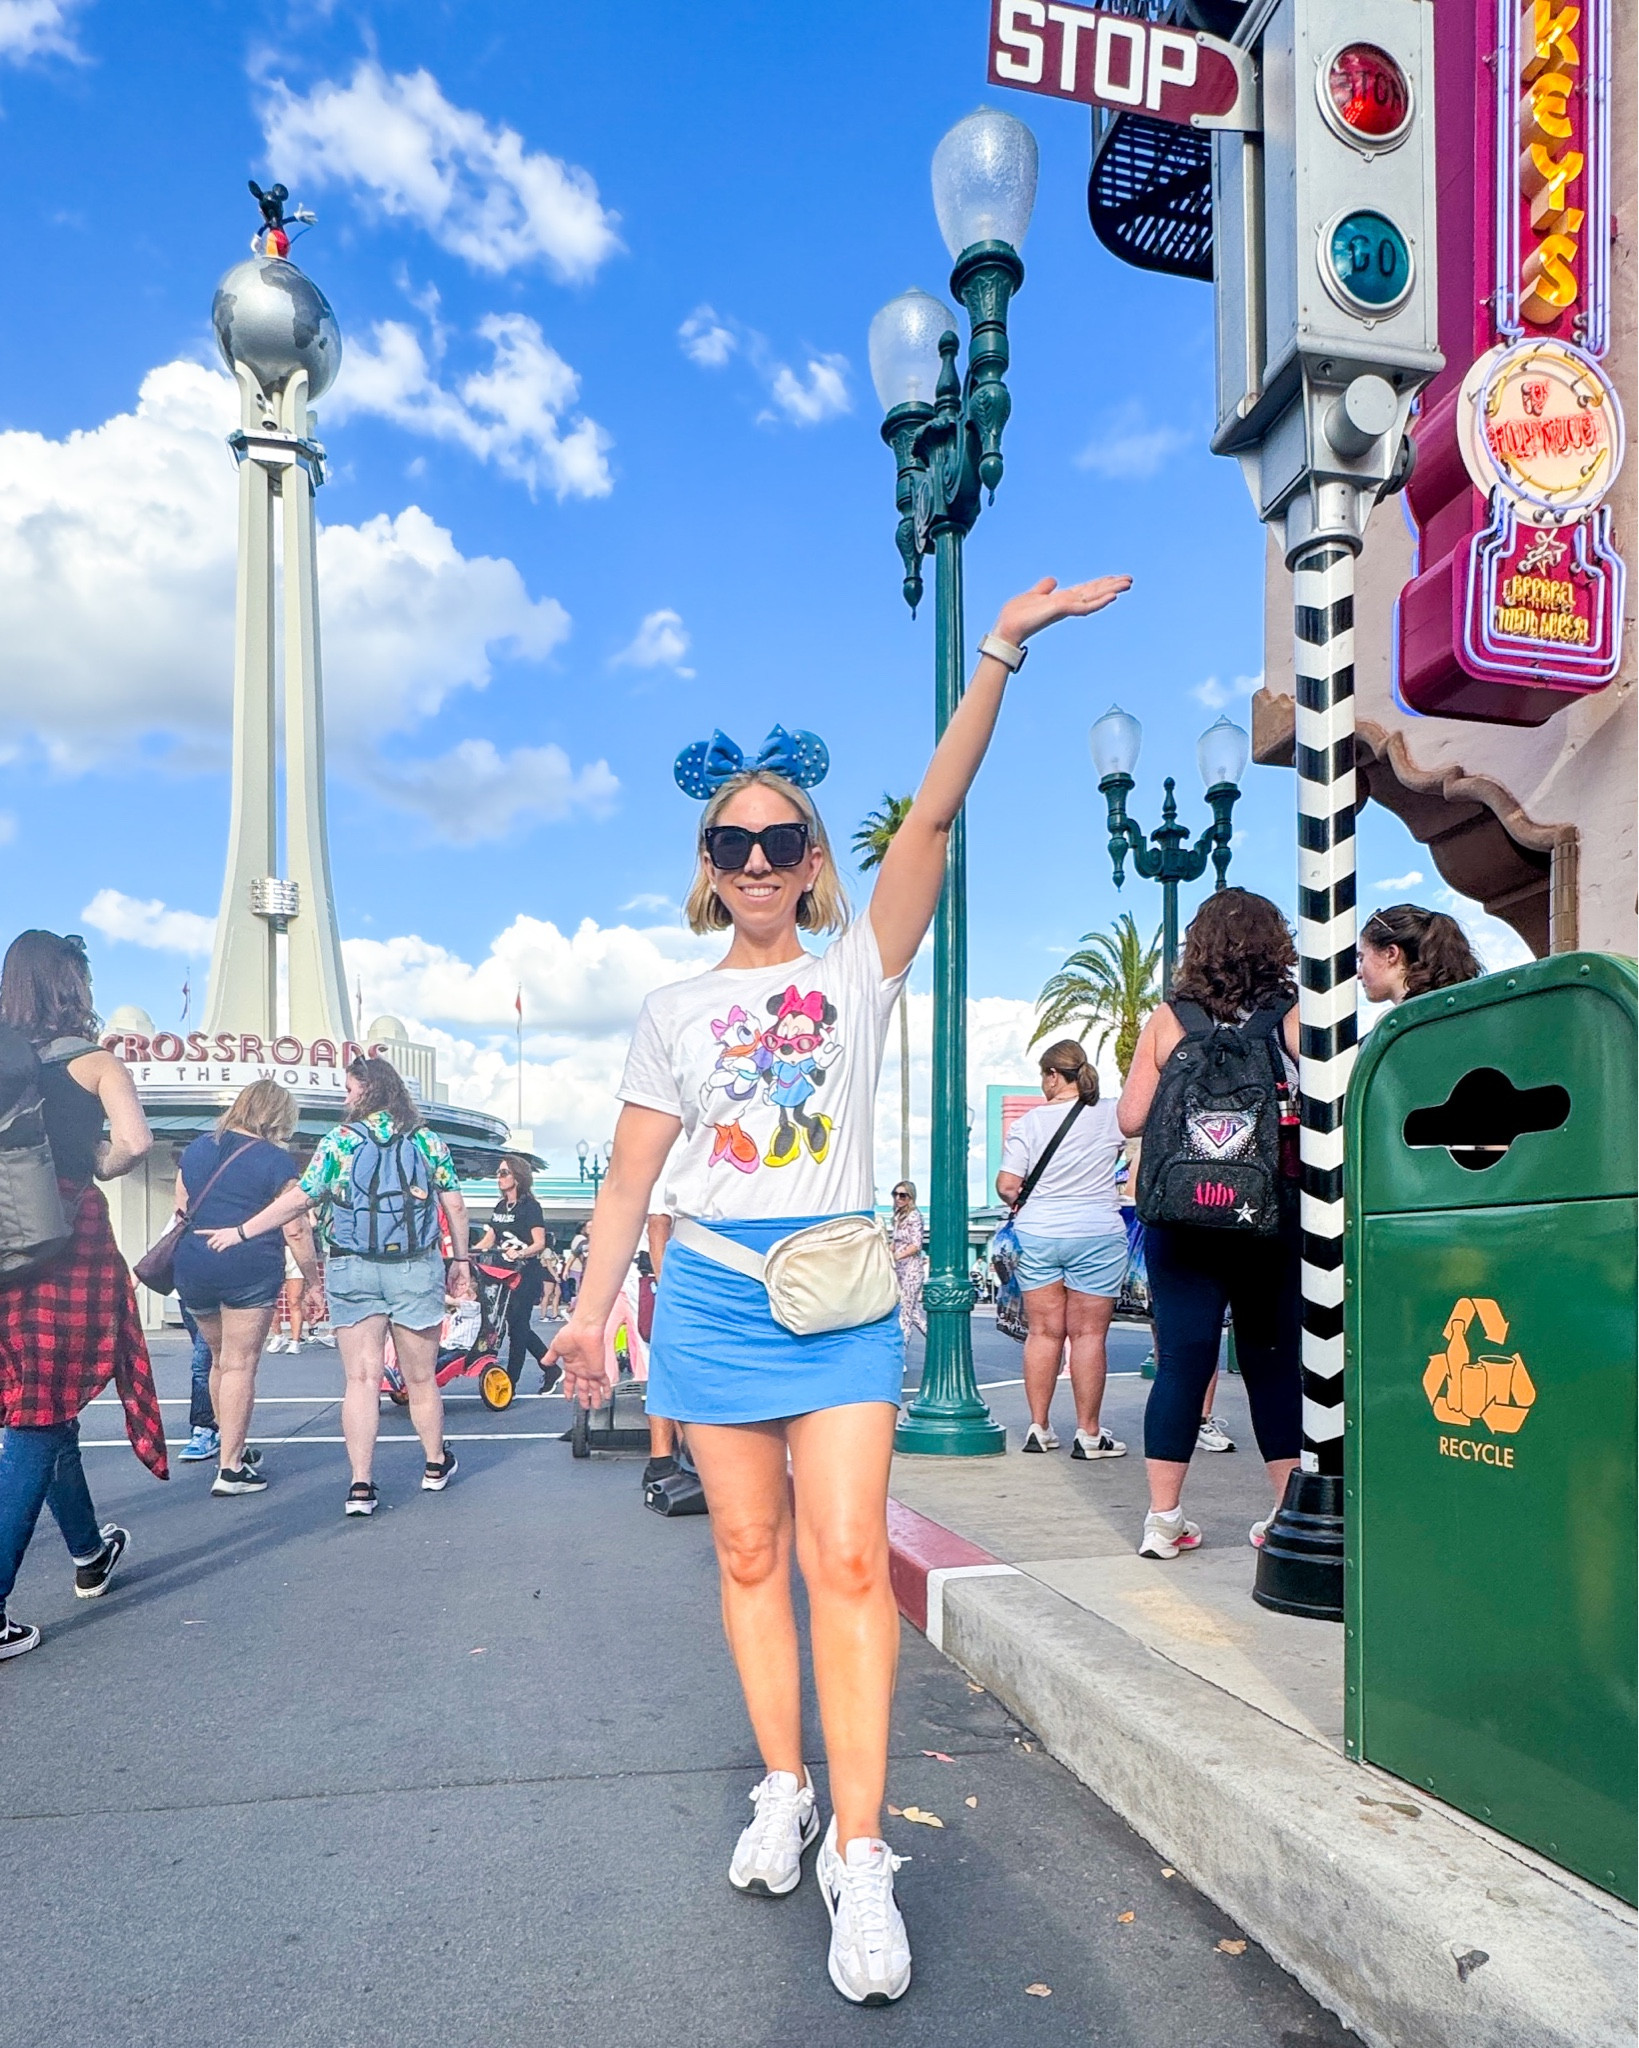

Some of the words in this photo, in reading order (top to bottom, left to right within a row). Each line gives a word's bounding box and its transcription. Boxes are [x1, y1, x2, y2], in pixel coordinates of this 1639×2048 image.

[996, 0, 1197, 111] STOP
[1350, 234, 1397, 278] GO
[177, 1067, 230, 1081] THE
[257, 1067, 341, 1087] WORL
[1439, 1435, 1514, 1469] RECYCLE
